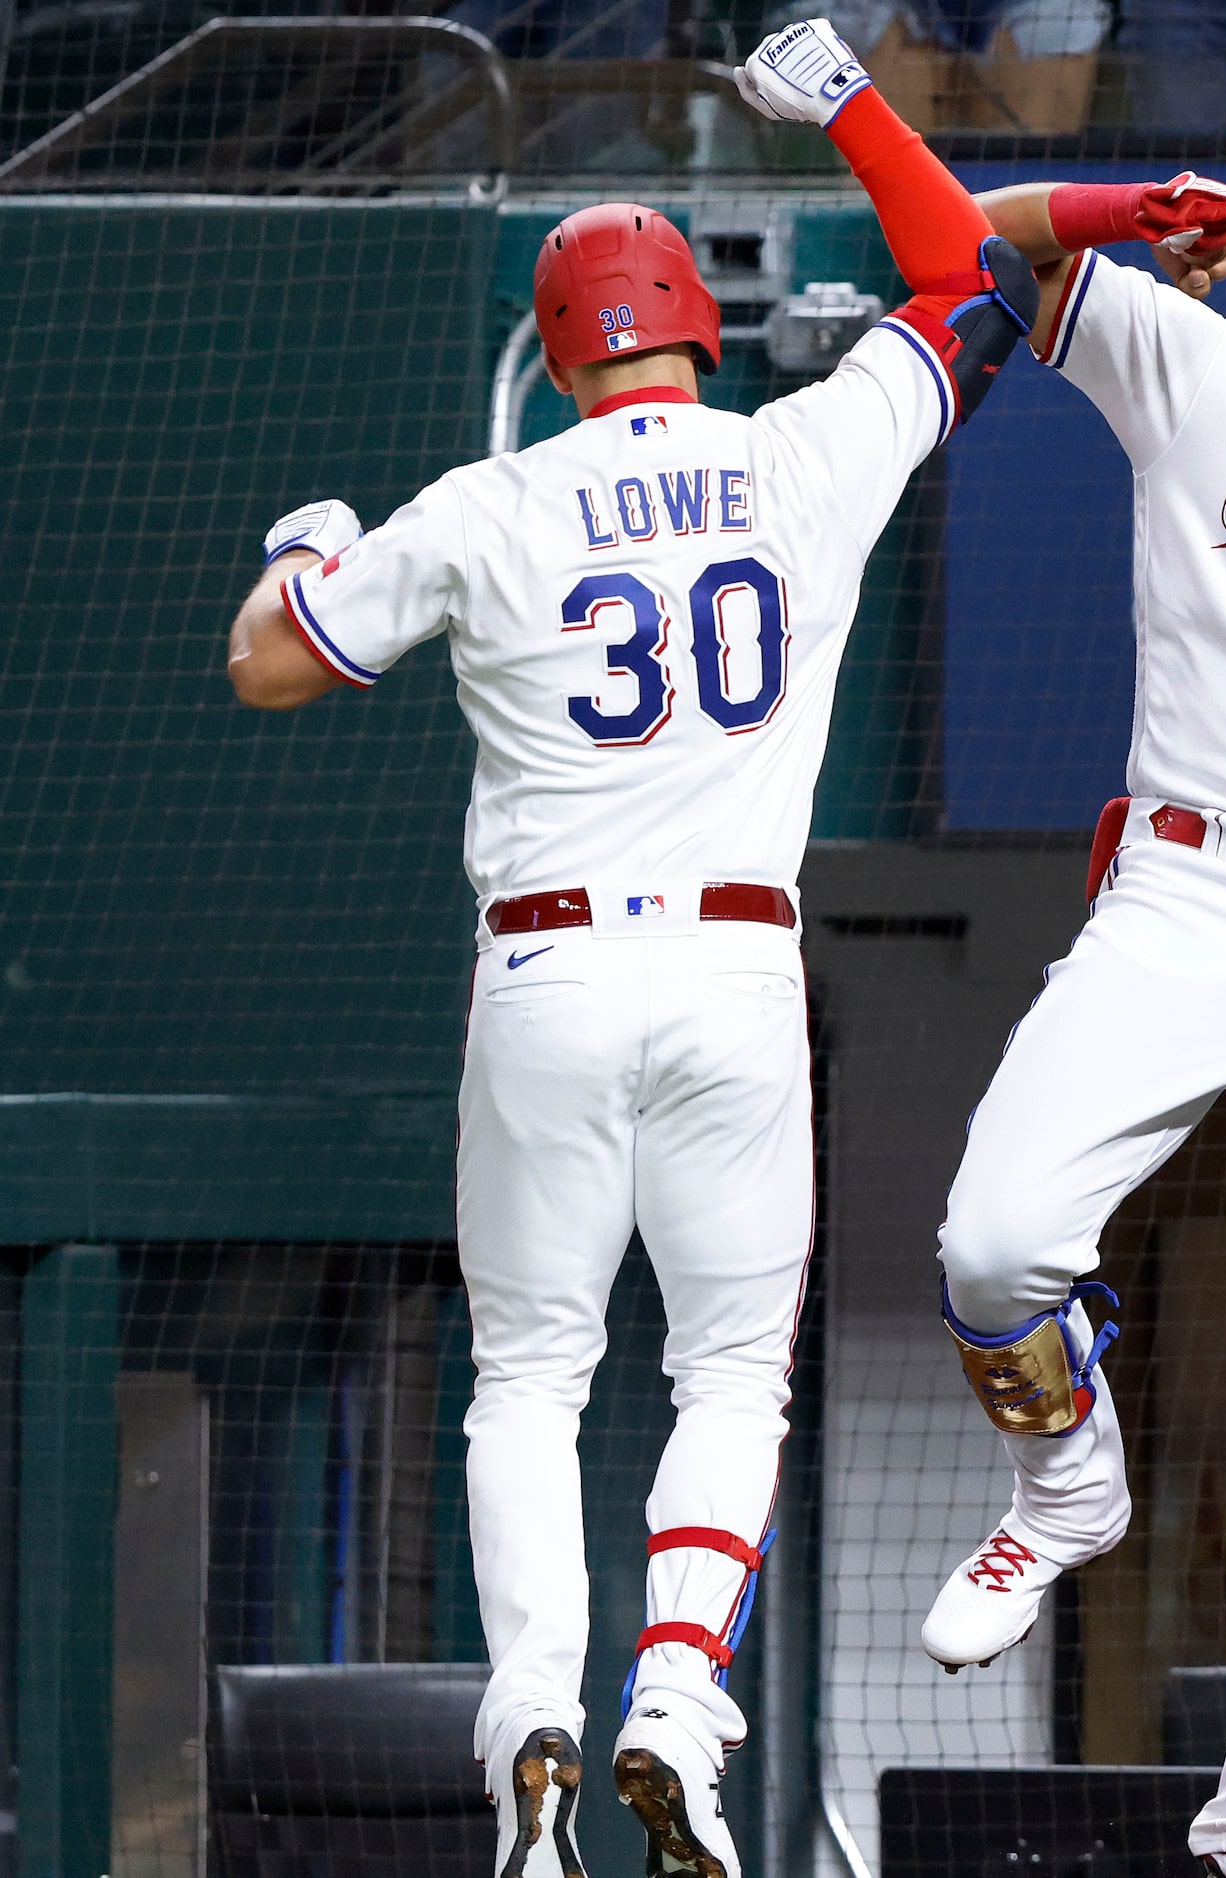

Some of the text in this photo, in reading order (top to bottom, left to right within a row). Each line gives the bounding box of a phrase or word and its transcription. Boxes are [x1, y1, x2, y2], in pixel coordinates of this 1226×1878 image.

[766, 25, 809, 65] franklin
[599, 304, 634, 332] 30
[575, 468, 752, 551] LOWE
[560, 556, 792, 747] 30
